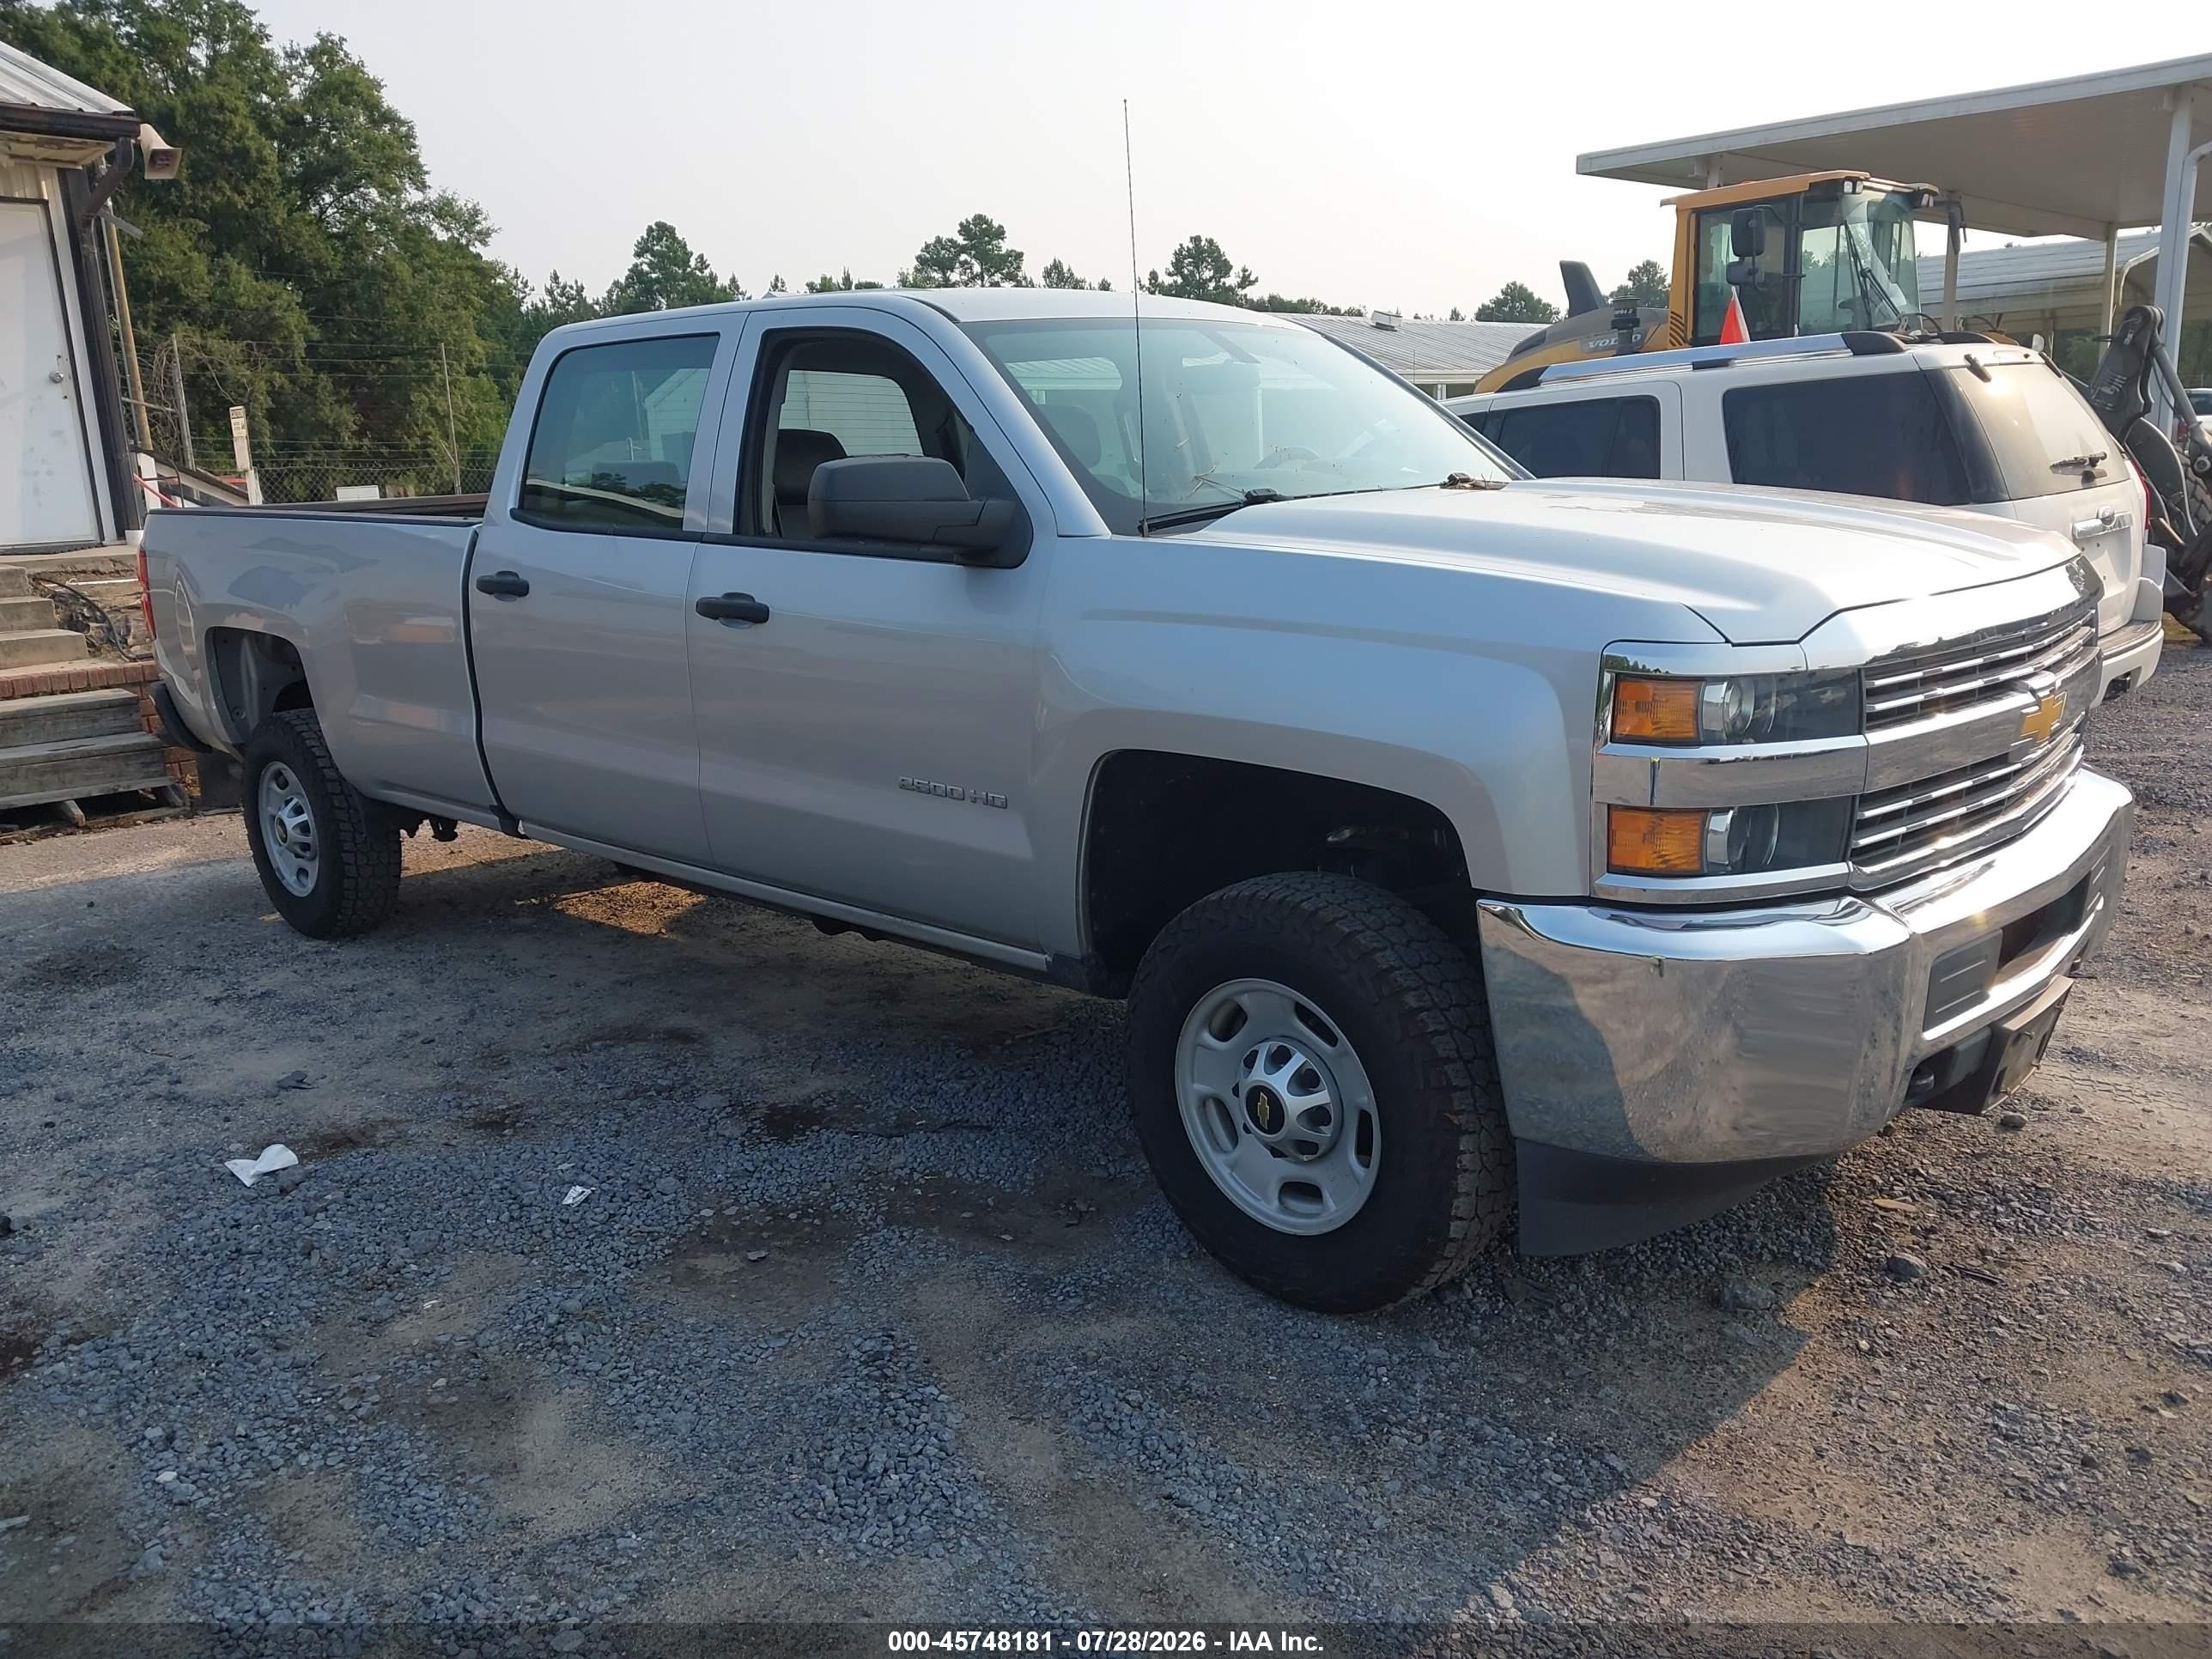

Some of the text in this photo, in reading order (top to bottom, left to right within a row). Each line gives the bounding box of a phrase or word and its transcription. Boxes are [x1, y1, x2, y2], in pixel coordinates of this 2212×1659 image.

[1587, 333, 1642, 349] VOLO
[898, 775, 1008, 809] 2500 HD
